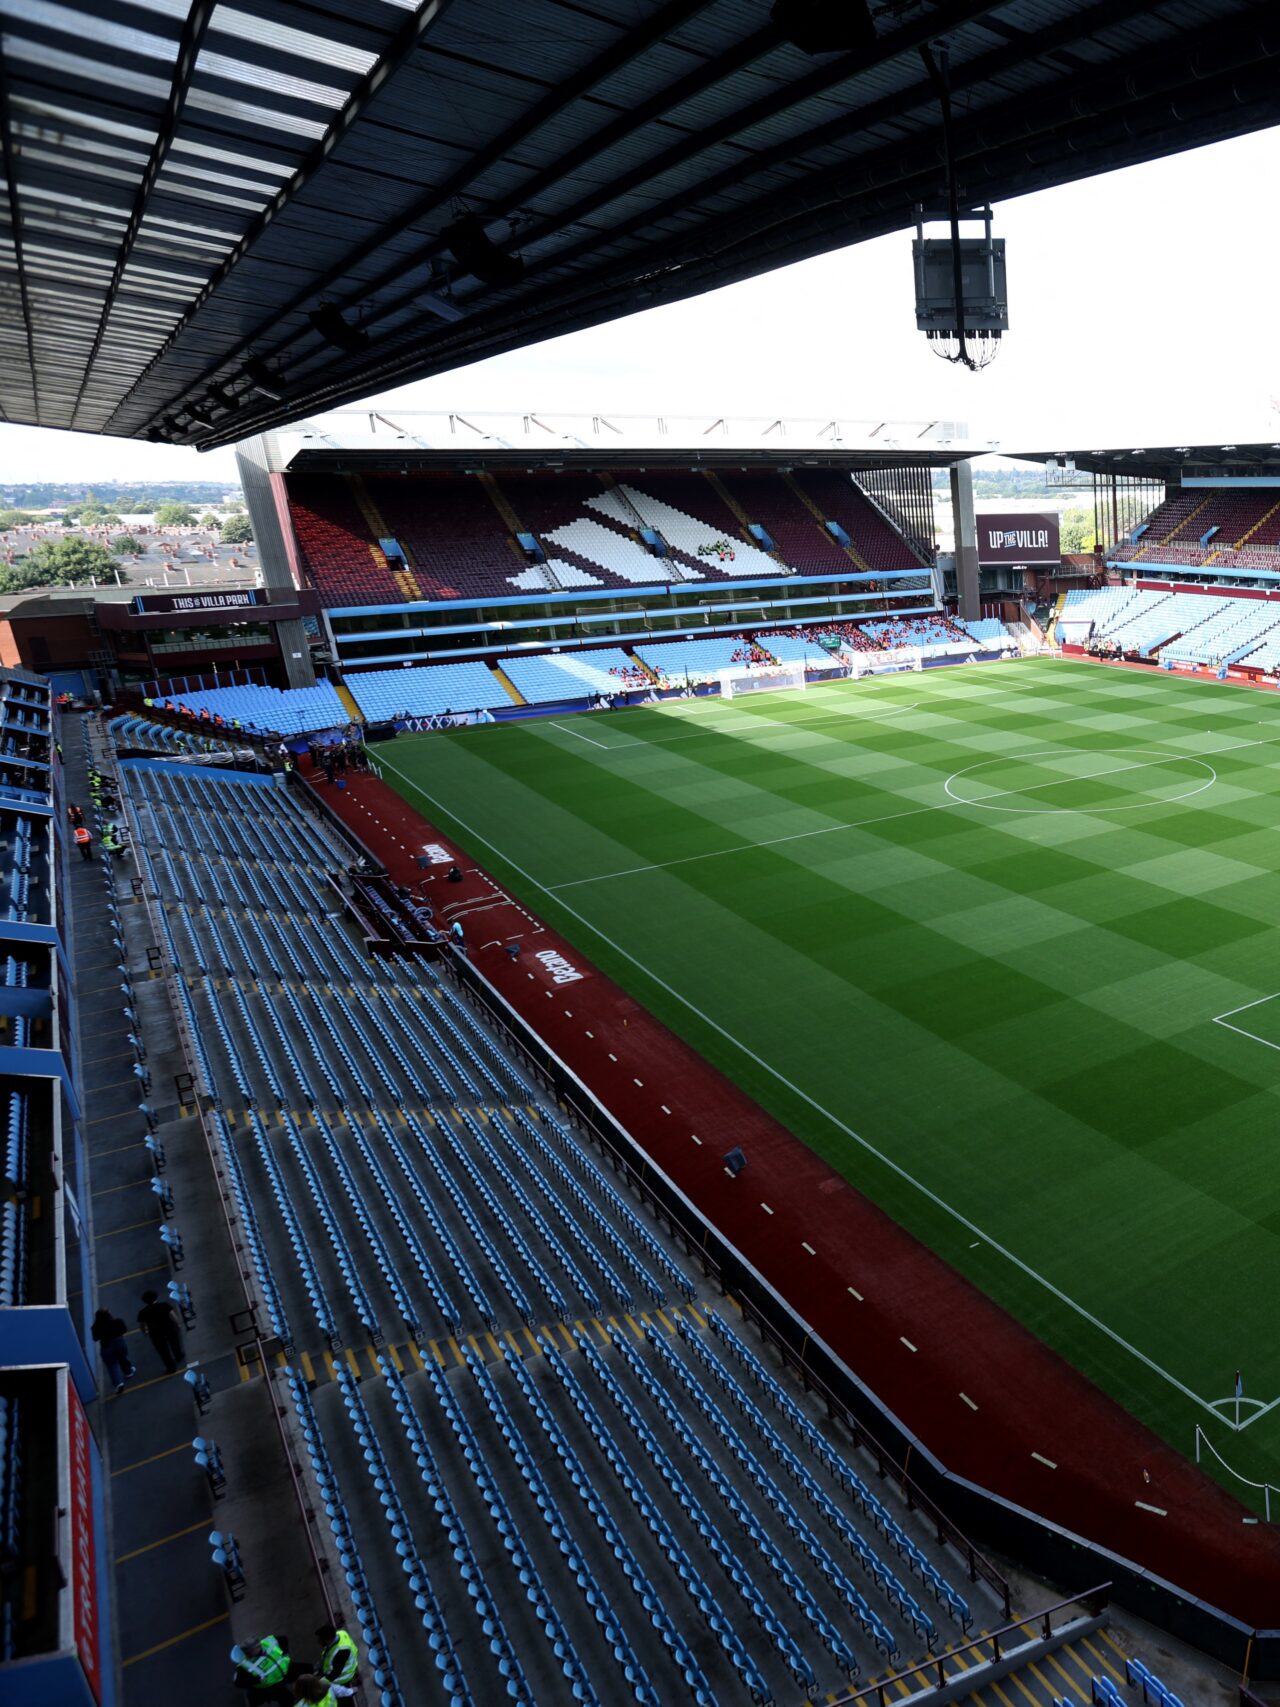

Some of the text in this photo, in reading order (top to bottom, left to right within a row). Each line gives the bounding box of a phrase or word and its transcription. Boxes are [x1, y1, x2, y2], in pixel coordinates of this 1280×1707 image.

[989, 530, 1048, 548] UP THE VILLA!
[172, 598, 194, 609] THIS
[201, 596, 225, 607] VILLA
[226, 595, 249, 605] PARK
[535, 950, 584, 984] Betano
[75, 1402, 93, 1639] TRADE NATION
